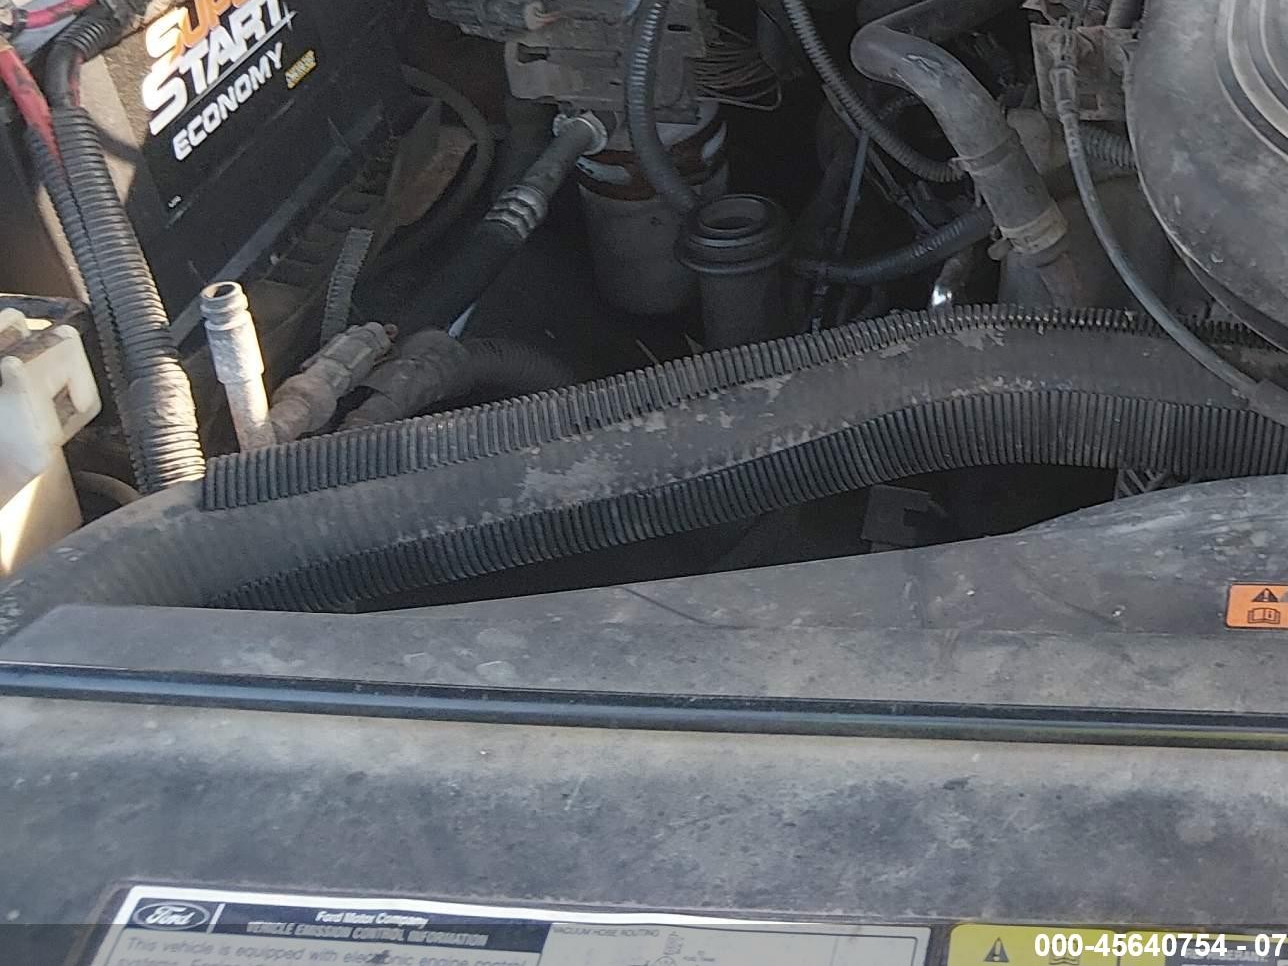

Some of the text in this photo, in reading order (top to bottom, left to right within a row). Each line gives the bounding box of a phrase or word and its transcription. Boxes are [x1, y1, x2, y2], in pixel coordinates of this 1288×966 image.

[172, 41, 283, 161] ECONOMY
[145, 905, 196, 926] Ford
[315, 910, 430, 930] Ford Motor Company
[352, 927, 405, 942] CONTROL
[406, 930, 489, 947] INFORMATION
[127, 936, 157, 952] This
[162, 938, 215, 956] vehicle
[235, 943, 306, 962] equipped
[309, 948, 338, 962] with
